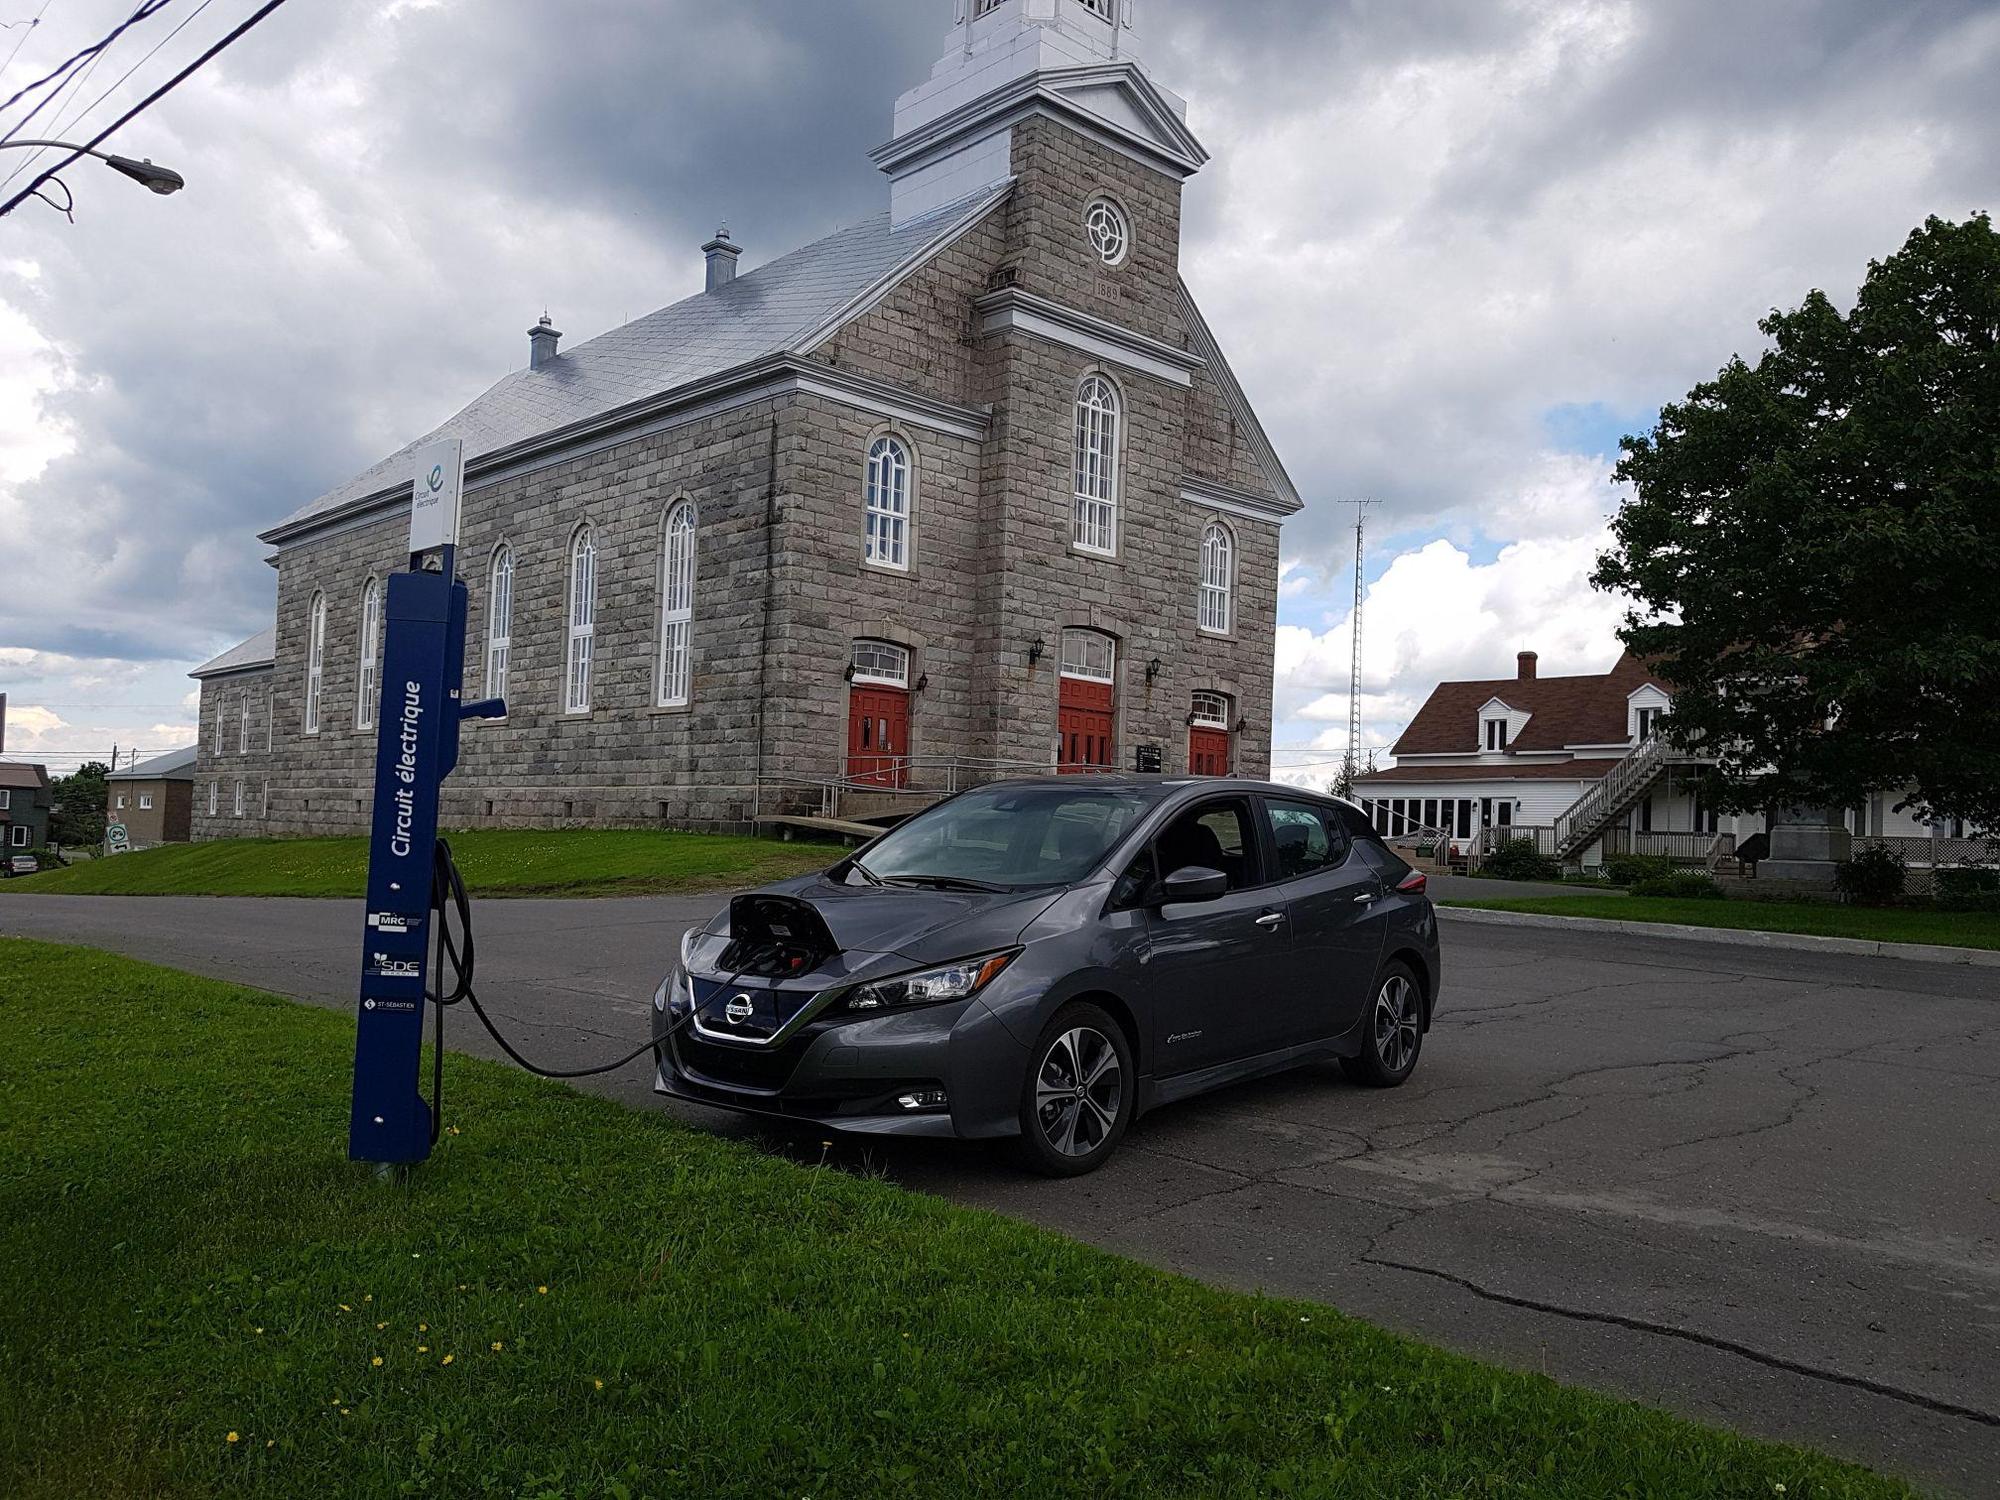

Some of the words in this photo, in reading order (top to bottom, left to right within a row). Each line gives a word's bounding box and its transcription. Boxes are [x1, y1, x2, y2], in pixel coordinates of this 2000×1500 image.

[1097, 283, 1117, 299] 1889
[395, 680, 424, 783] électrique
[391, 788, 413, 857] Circuit
[380, 916, 405, 925] MRC
[381, 961, 420, 971] SDE
